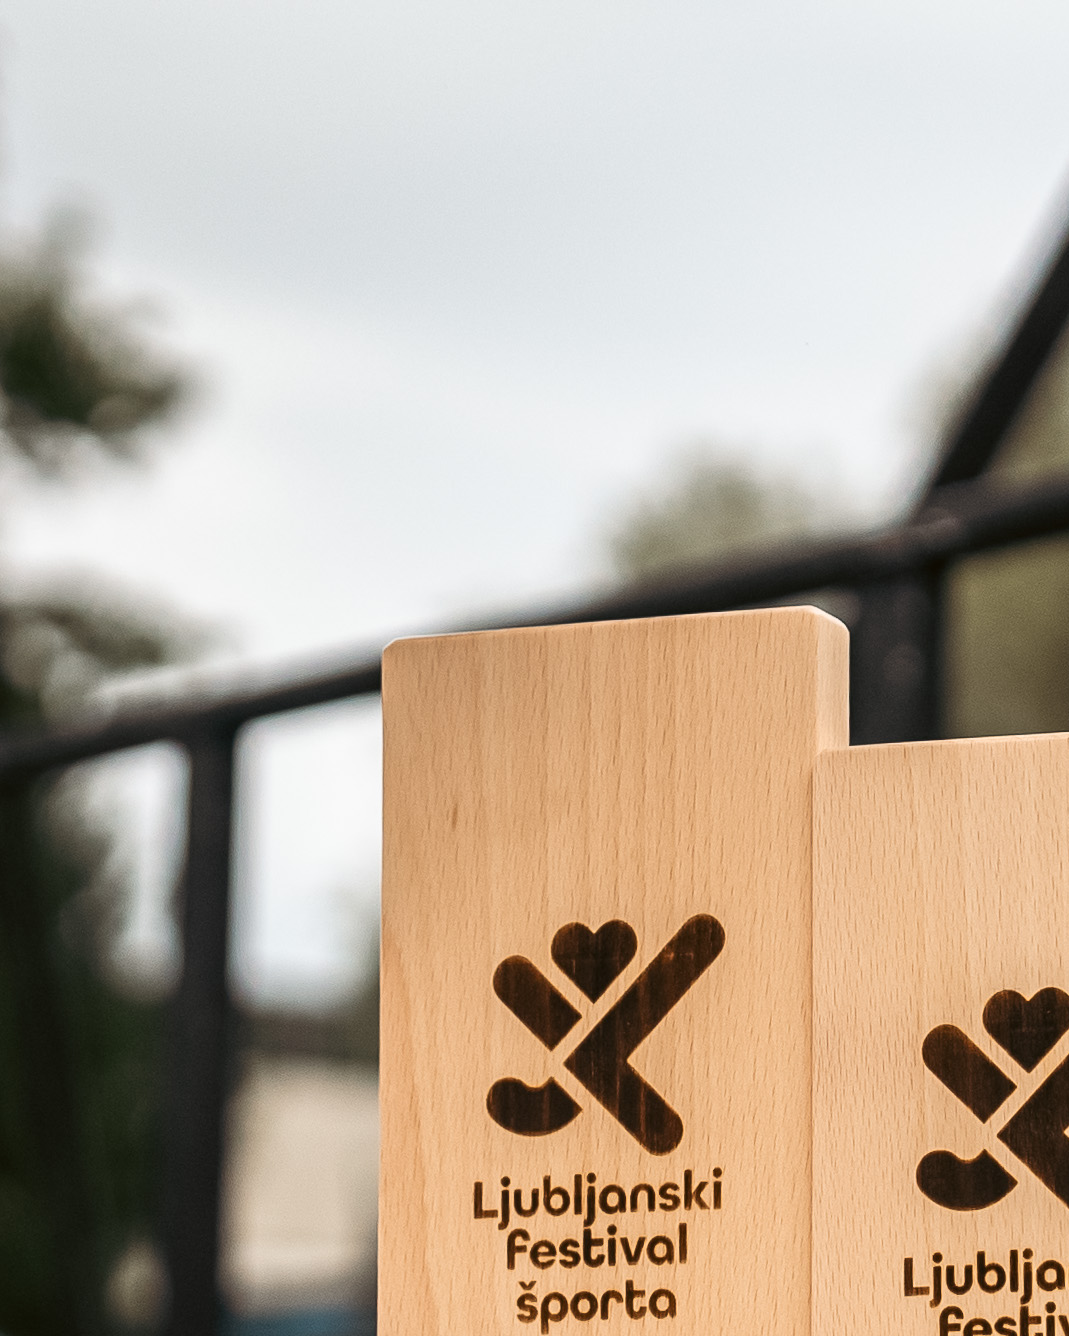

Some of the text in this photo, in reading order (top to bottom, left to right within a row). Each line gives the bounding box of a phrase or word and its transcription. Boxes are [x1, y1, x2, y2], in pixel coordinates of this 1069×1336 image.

[472, 1167, 723, 1230] Ljubljanski
[505, 1223, 689, 1271] festival
[516, 1279, 677, 1335] športa
